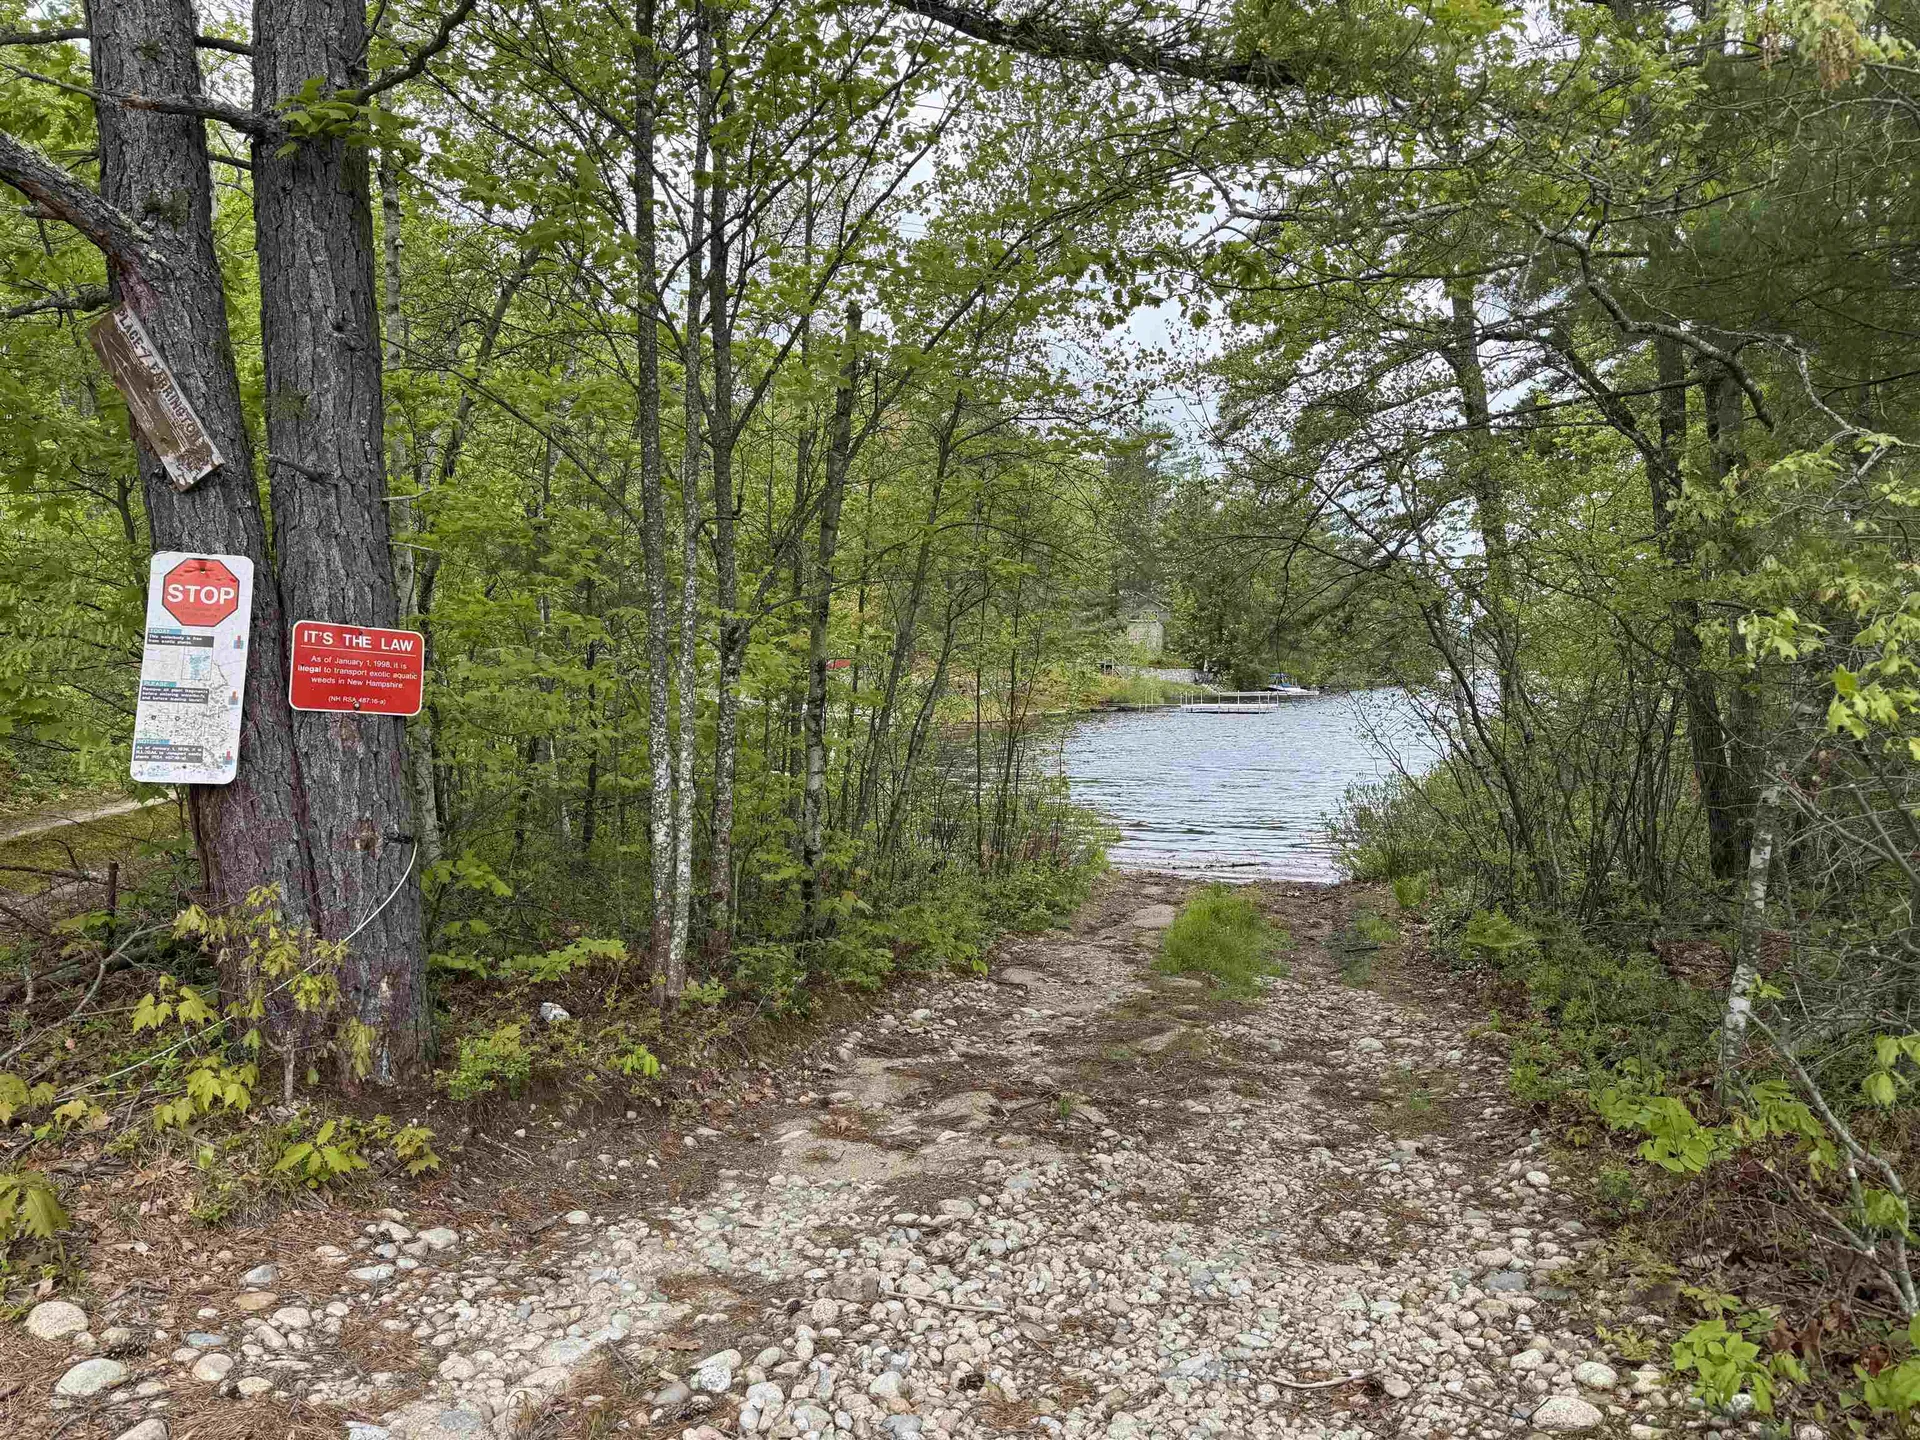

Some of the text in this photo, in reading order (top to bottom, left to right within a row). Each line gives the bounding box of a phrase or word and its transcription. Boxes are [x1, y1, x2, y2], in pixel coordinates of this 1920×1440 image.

[167, 584, 234, 604] STOP
[304, 630, 413, 651] IT'S THE LAW
[335, 657, 363, 666] January
[334, 668, 367, 677] transport
